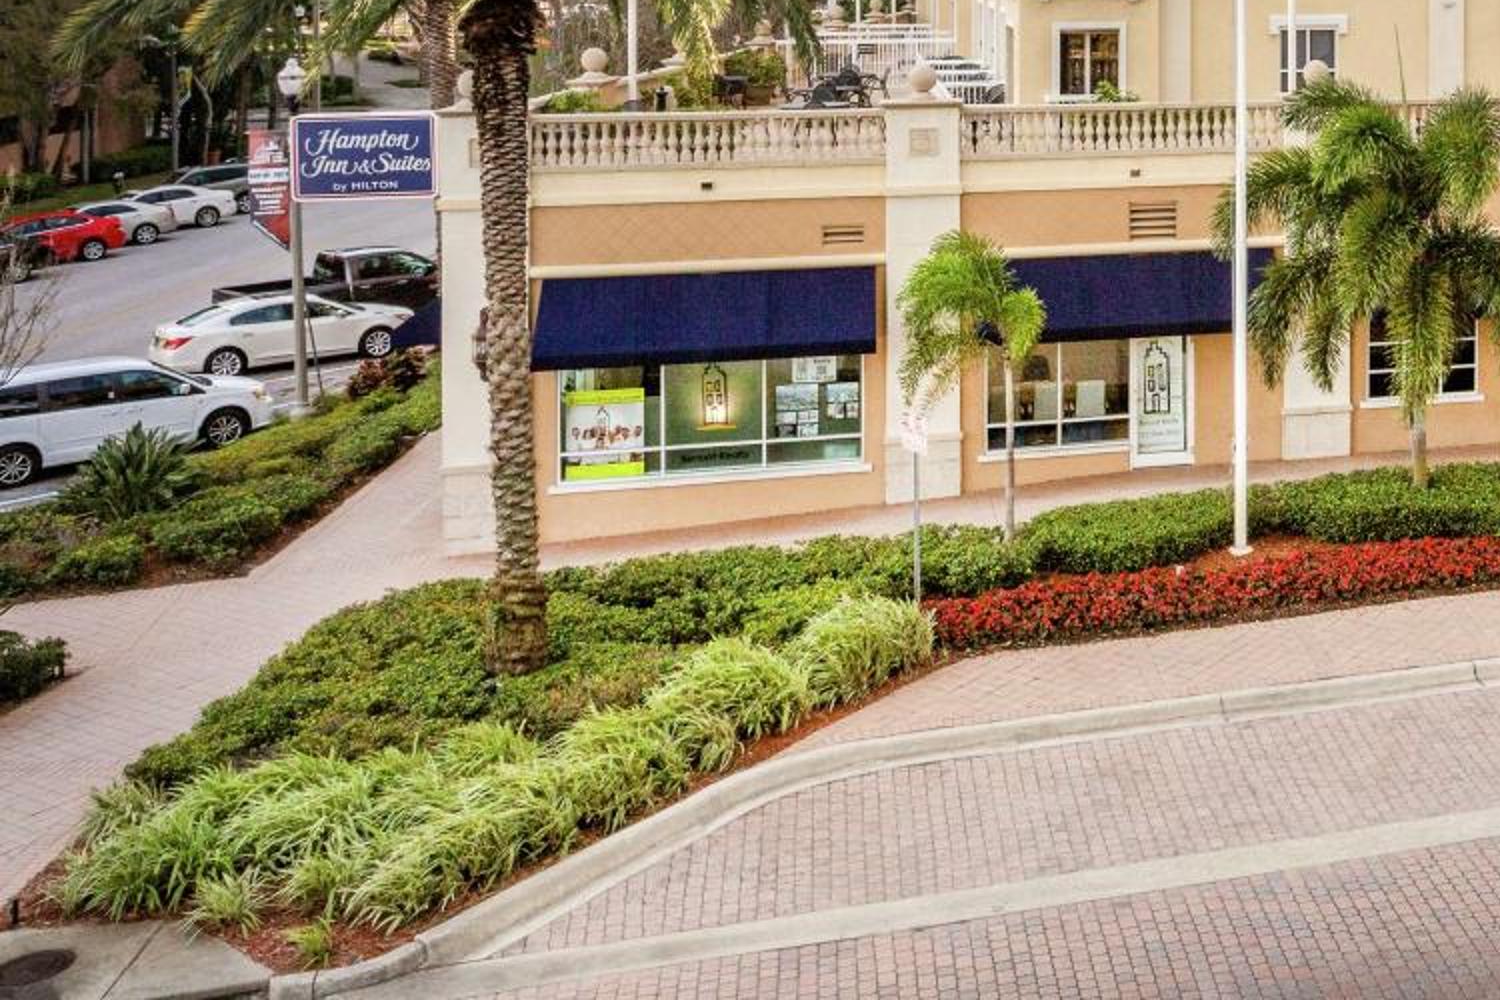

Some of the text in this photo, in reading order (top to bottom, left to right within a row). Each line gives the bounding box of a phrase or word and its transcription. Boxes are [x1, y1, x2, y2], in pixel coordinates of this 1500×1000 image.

[305, 128, 419, 157] Hampton
[301, 155, 357, 178] Inn
[357, 160, 375, 175] &
[371, 152, 431, 173] Suites
[333, 180, 399, 193] by HILTON
